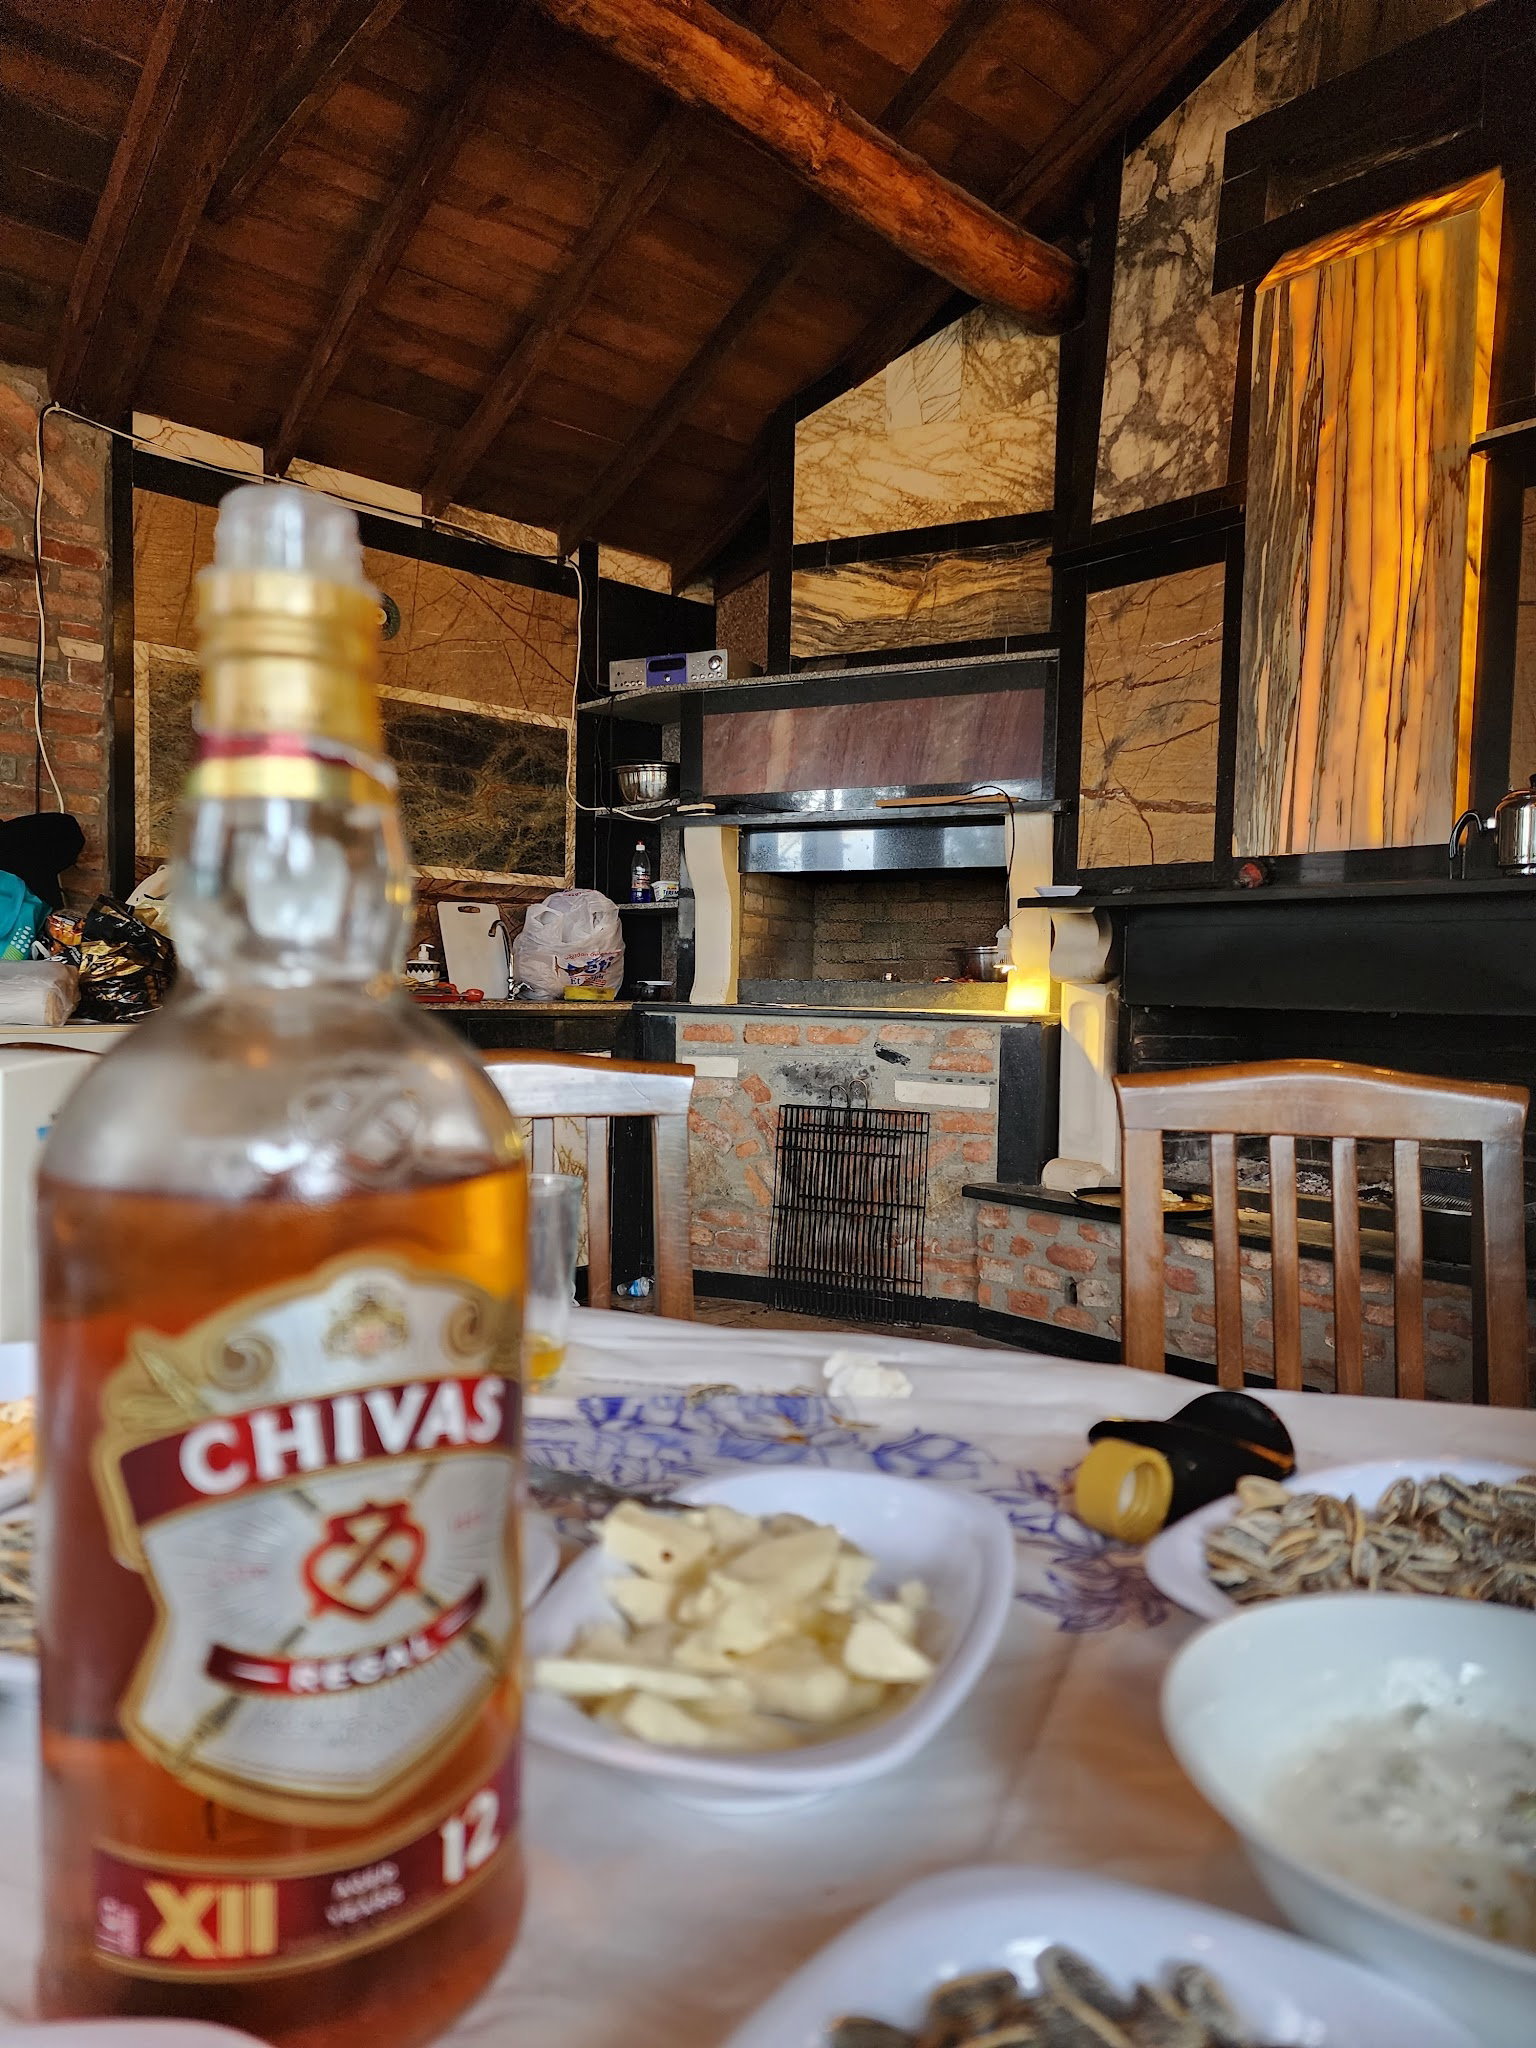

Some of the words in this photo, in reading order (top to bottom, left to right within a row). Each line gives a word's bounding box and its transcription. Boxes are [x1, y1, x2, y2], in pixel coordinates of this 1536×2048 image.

[179, 1375, 505, 1495] CHIVAS
[288, 1633, 431, 1694] REGAL
[441, 1790, 501, 1885] 12
[143, 1878, 279, 1960] XII
